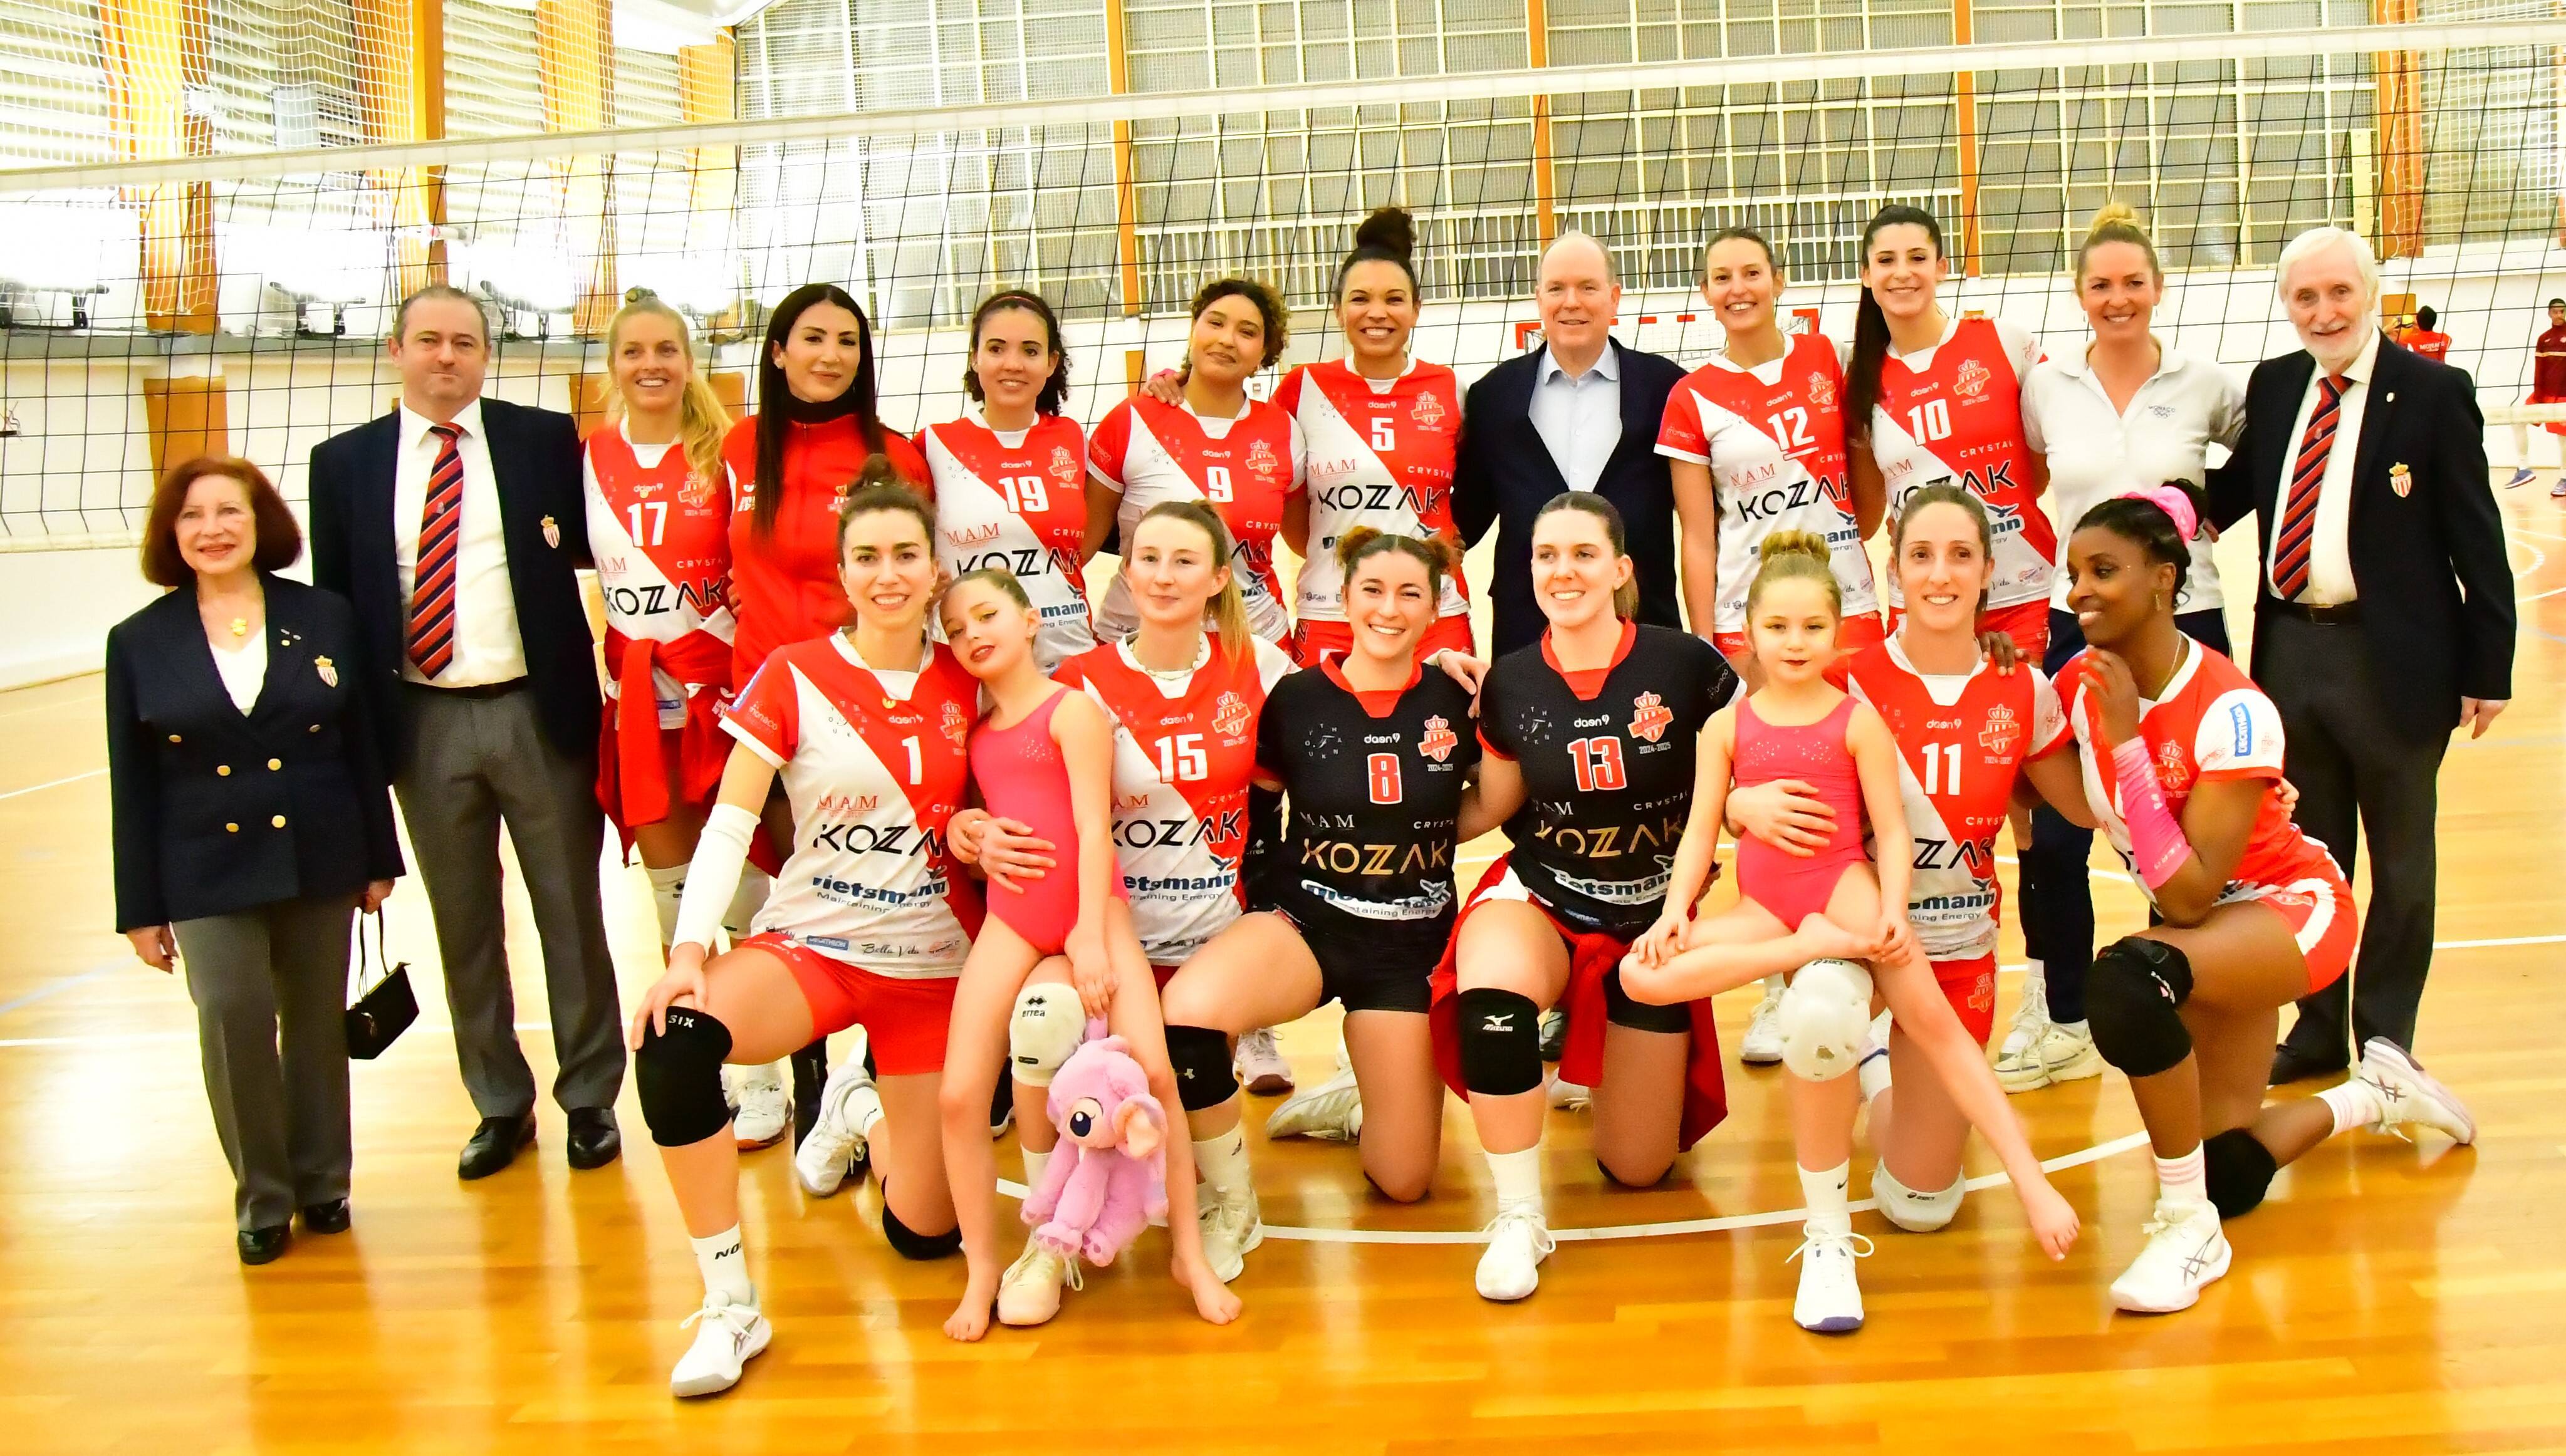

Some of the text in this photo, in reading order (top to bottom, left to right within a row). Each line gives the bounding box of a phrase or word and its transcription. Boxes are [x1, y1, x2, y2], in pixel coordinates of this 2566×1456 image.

[1372, 417, 1395, 451] 5
[1767, 407, 1815, 452] 12
[1907, 398, 1952, 446] 10
[998, 476, 1049, 512] 19
[1207, 466, 1233, 502] 9
[627, 502, 667, 547] 17
[902, 736, 922, 785] 1
[1154, 733, 1208, 784] 15
[1567, 736, 1627, 792] 13
[1639, 741, 1671, 754] 2024-2025
[1921, 742, 1961, 796] 11
[1367, 752, 1402, 804] 8
[668, 1015, 694, 1028] SIX
[715, 1242, 741, 1260] NO
